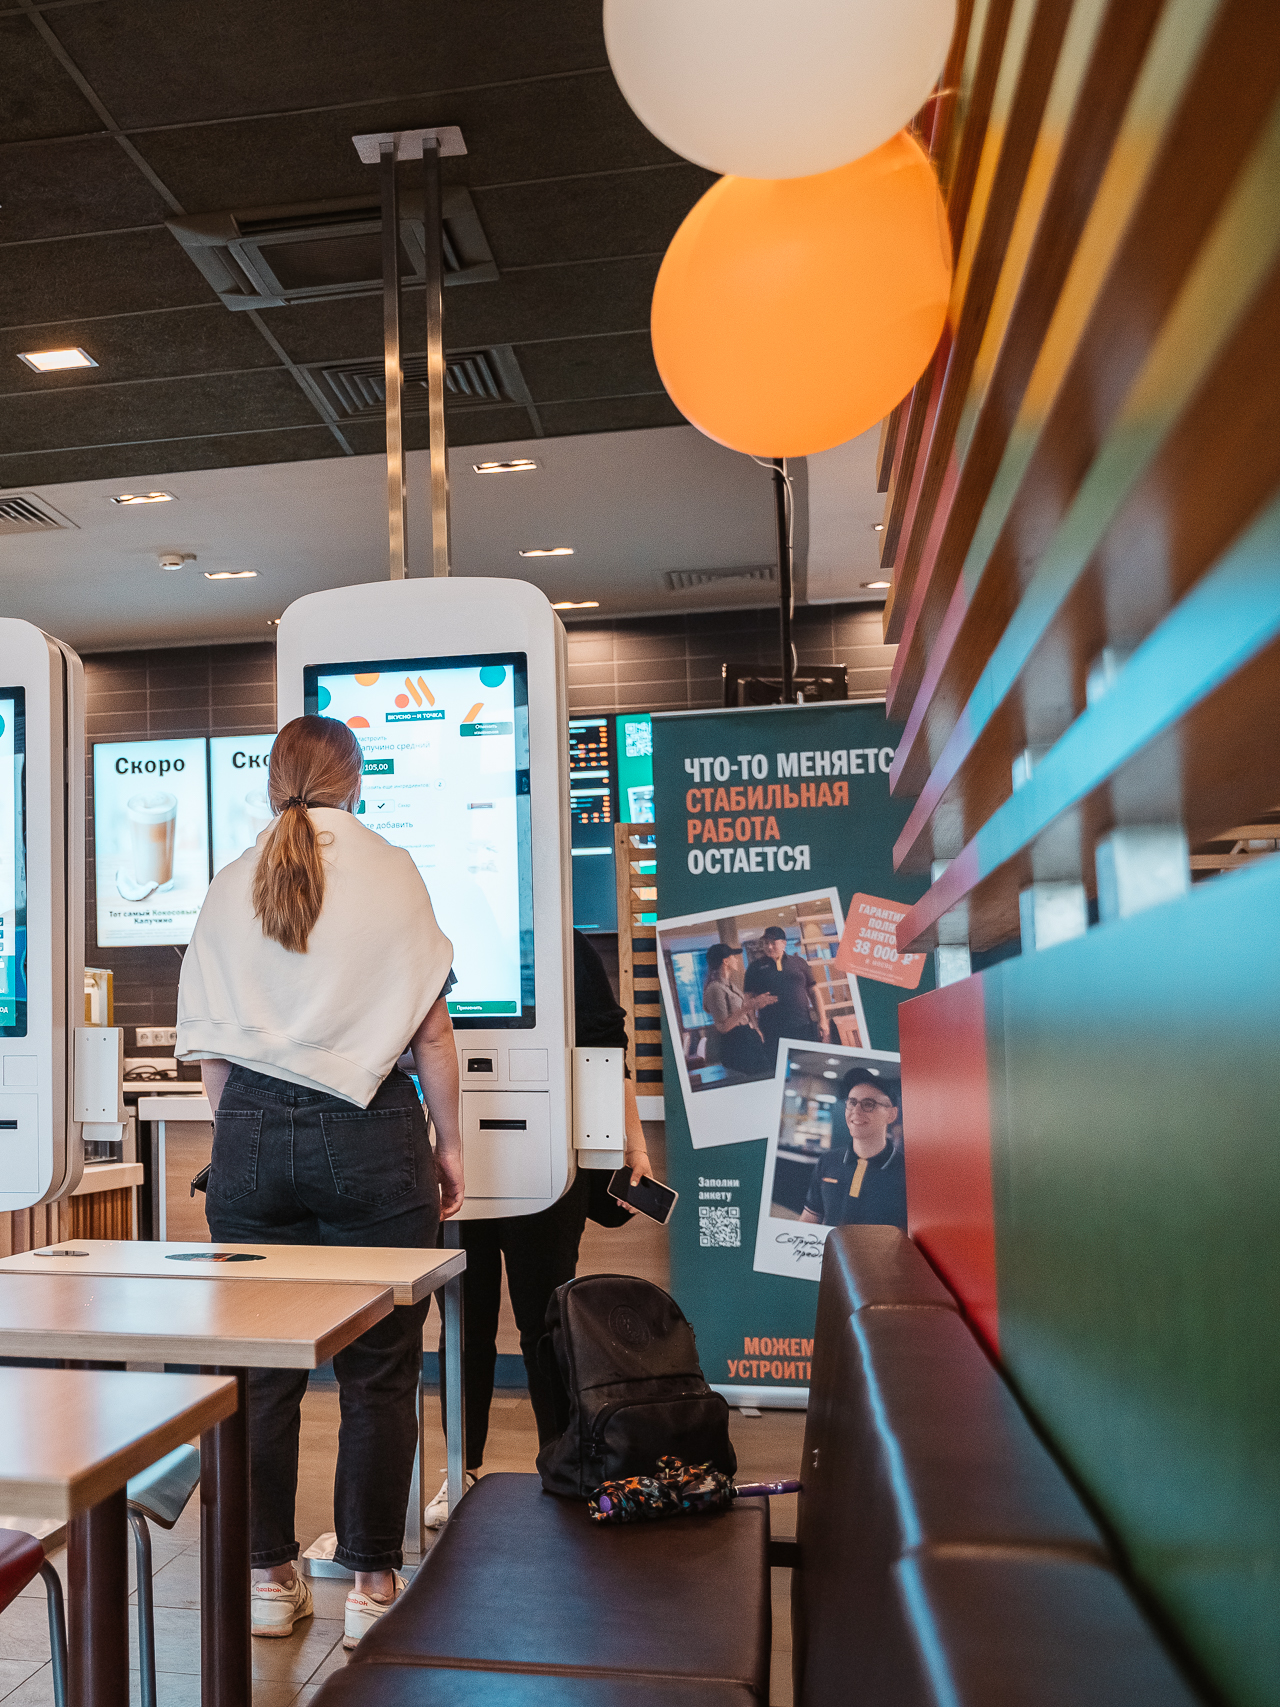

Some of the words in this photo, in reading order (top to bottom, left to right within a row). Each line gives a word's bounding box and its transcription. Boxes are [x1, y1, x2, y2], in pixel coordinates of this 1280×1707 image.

[361, 743, 395, 753] апучино
[115, 757, 186, 777] Скоро
[364, 763, 389, 772] 105,00
[684, 754, 769, 783] ЧТО-ТО
[776, 747, 895, 778] МЕНЯЕТС
[685, 781, 849, 813] СТАБИЛЬНАЯ
[376, 820, 414, 831] добавить
[687, 815, 780, 844] РАБОТА
[687, 845, 811, 875] ОСТАЕТСЯ
[123, 909, 150, 917] самый
[151, 908, 198, 917] Кокосовый
[134, 918, 173, 926] Капучино
[853, 939, 871, 955] 38
[873, 944, 899, 962] 000
[698, 1176, 740, 1187] Заполни
[698, 1191, 732, 1202] анкету
[744, 1336, 815, 1357] МОЖЕМ
[346, 1597, 368, 1606] eebok
